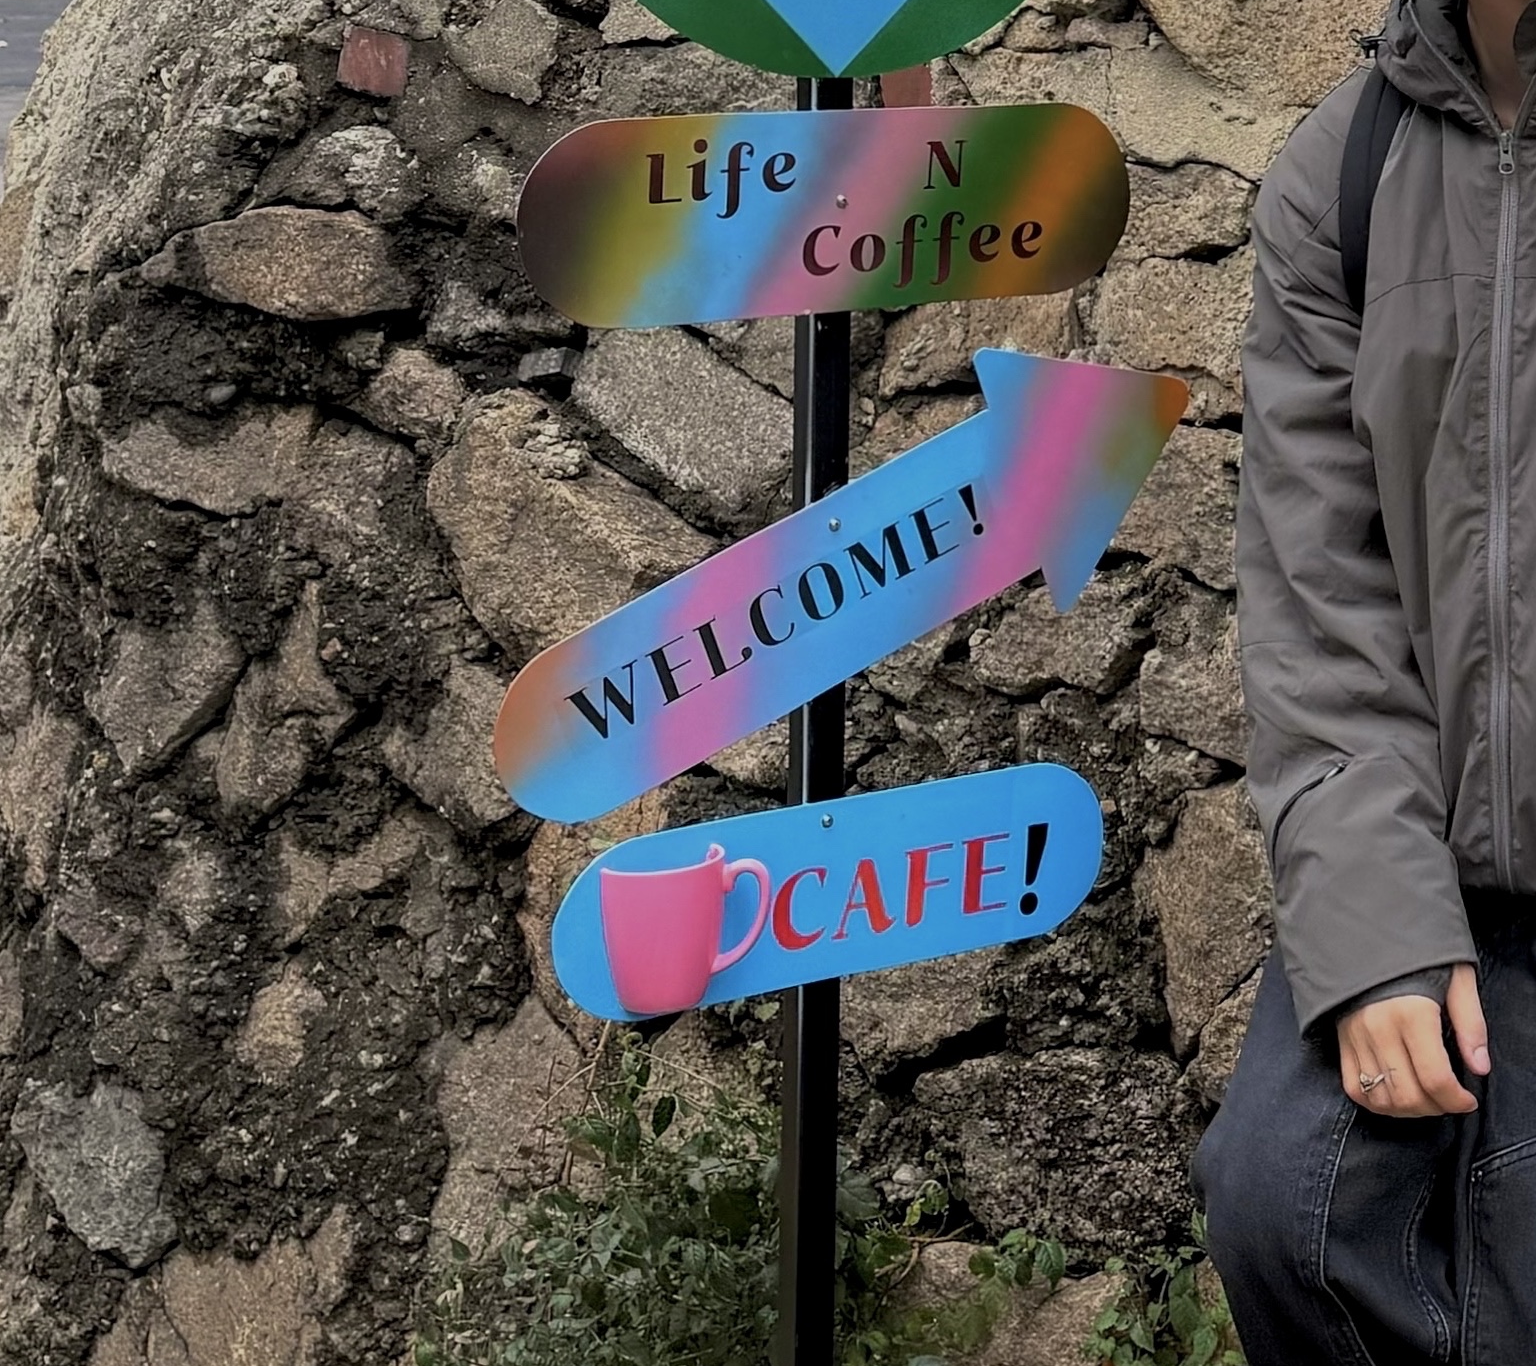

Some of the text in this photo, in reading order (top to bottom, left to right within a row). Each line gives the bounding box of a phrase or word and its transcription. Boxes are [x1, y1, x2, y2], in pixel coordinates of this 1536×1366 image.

[647, 137, 969, 221] Life N
[801, 211, 1045, 288] Coffee
[564, 483, 990, 742] WELCOME!
[771, 823, 1050, 951] CAFE!
